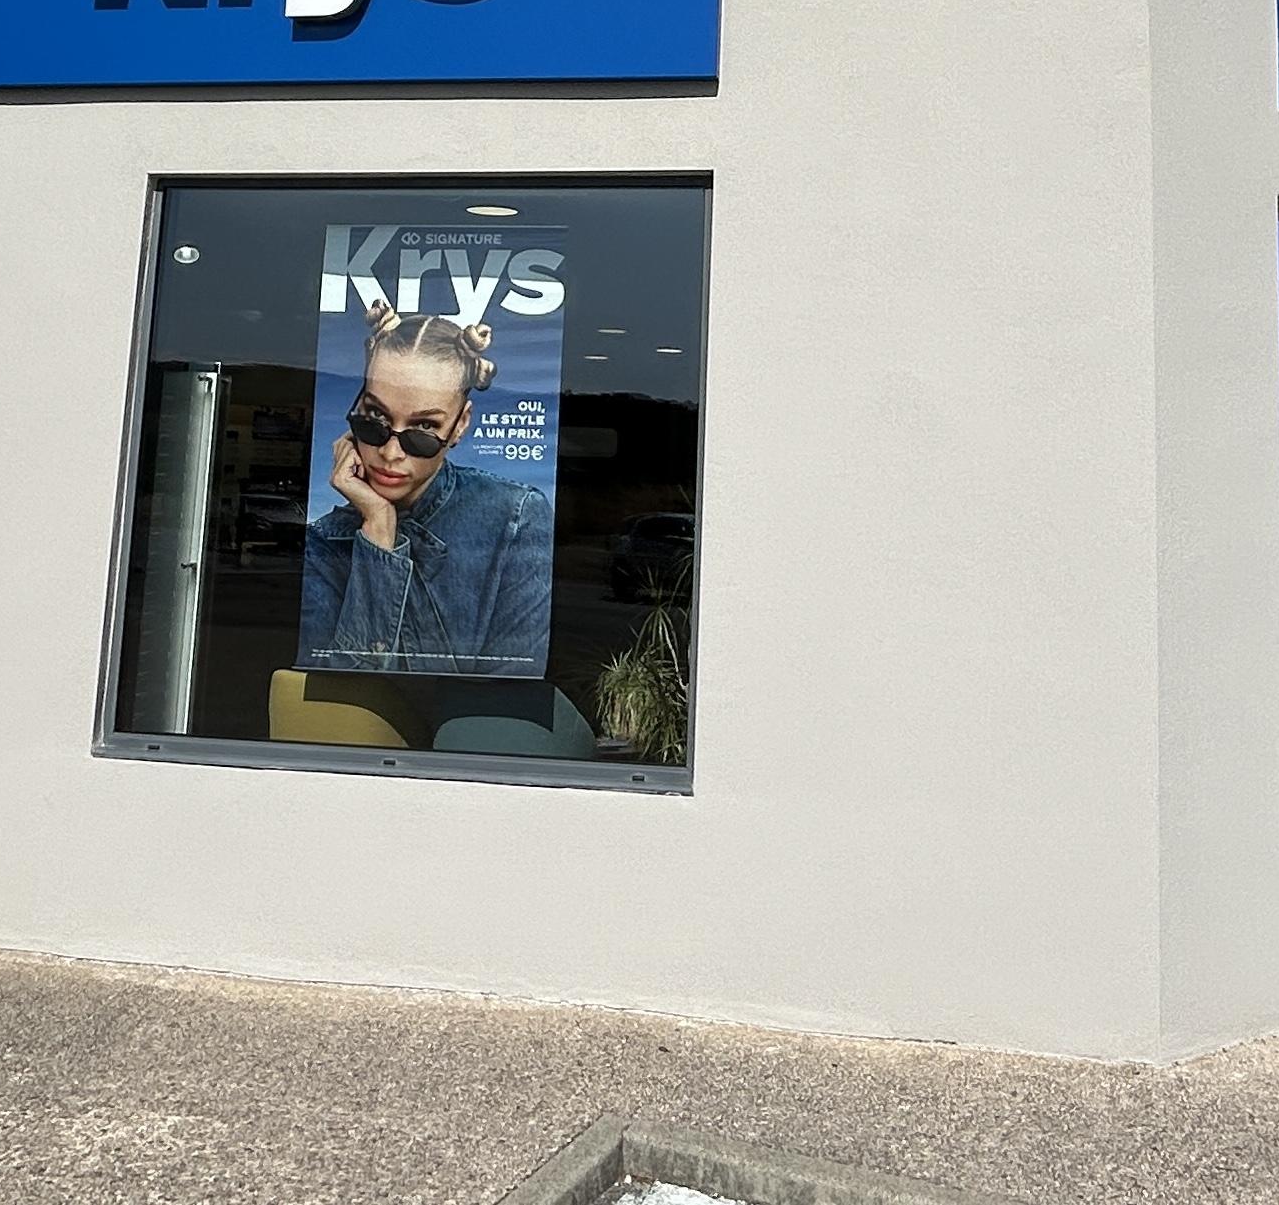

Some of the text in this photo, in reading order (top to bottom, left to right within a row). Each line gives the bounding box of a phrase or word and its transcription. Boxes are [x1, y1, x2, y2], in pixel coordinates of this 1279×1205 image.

[424, 233, 503, 246] SIGNATURE
[319, 224, 566, 331] Krys
[517, 400, 546, 414] OUI,
[481, 413, 546, 426] LE STYLE
[473, 427, 545, 439] A UN PRIX.
